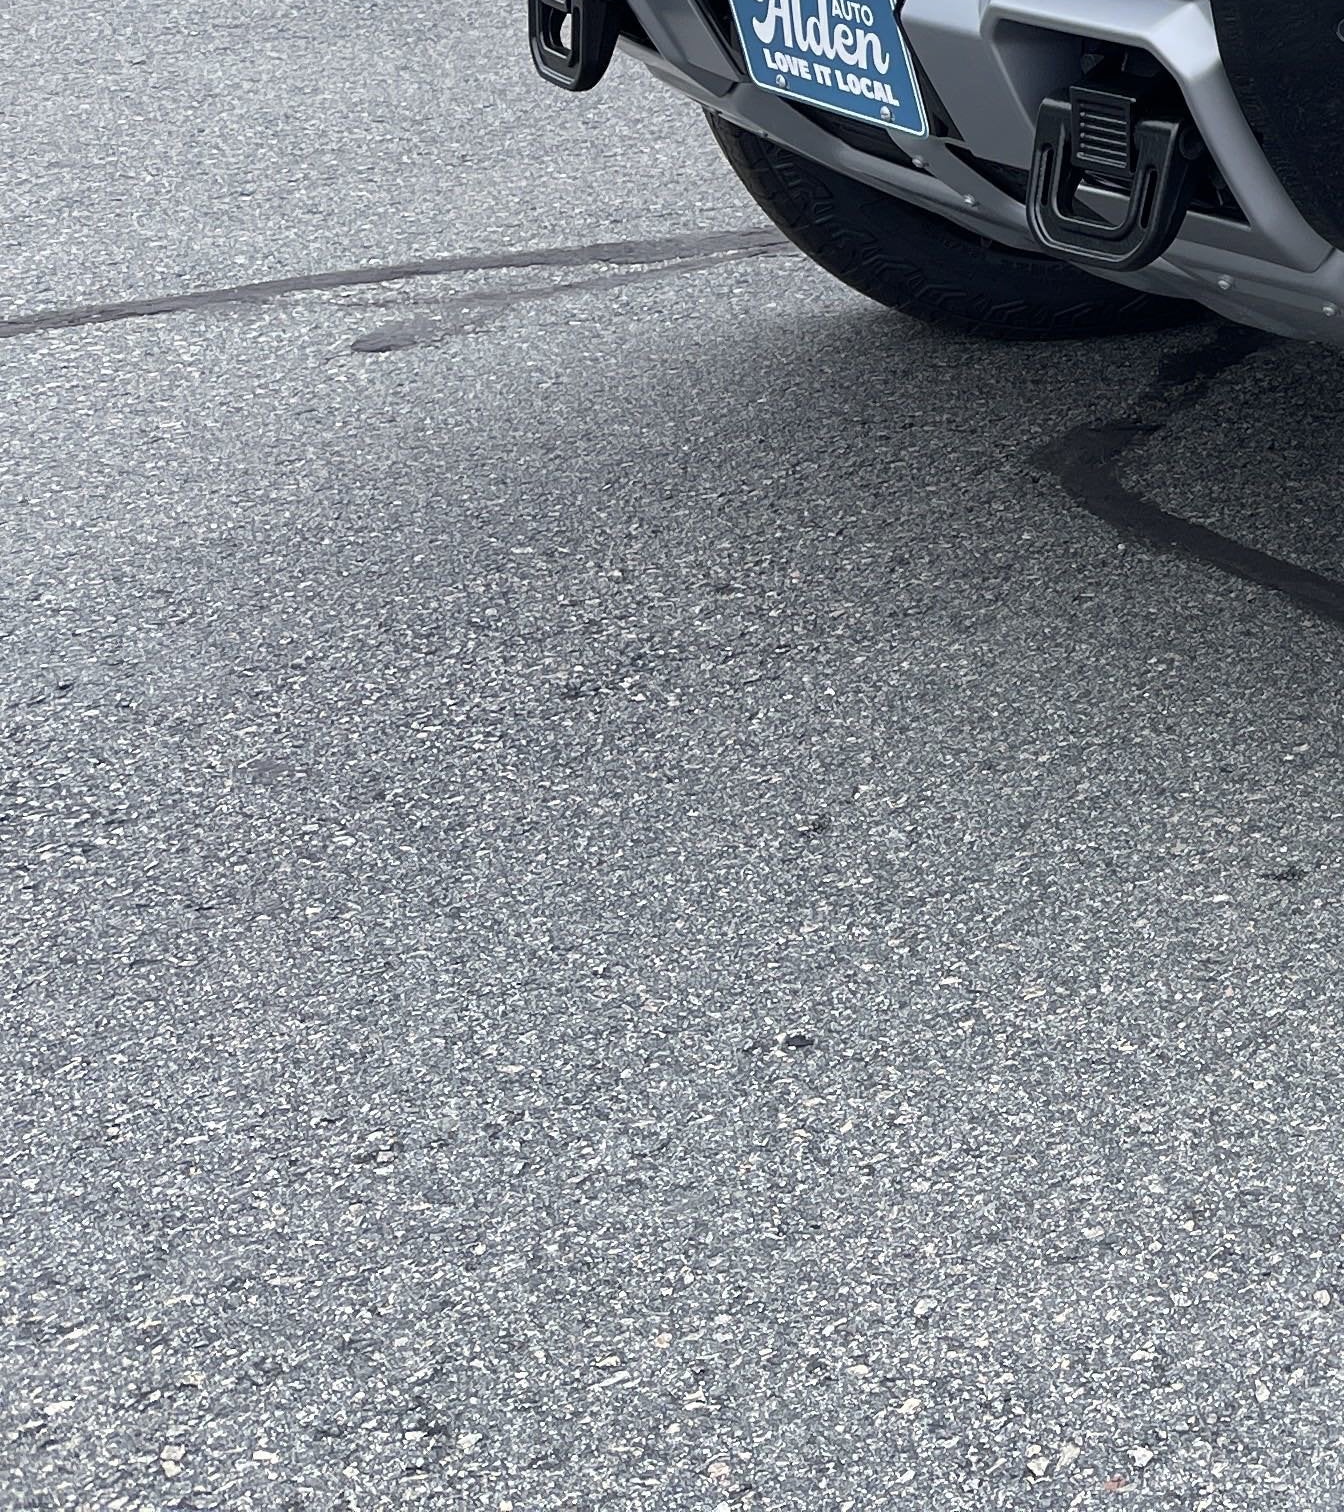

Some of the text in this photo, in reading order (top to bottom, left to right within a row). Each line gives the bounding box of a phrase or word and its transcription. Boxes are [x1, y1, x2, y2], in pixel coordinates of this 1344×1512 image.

[763, 47, 900, 107] LOVE IT LOCAL
